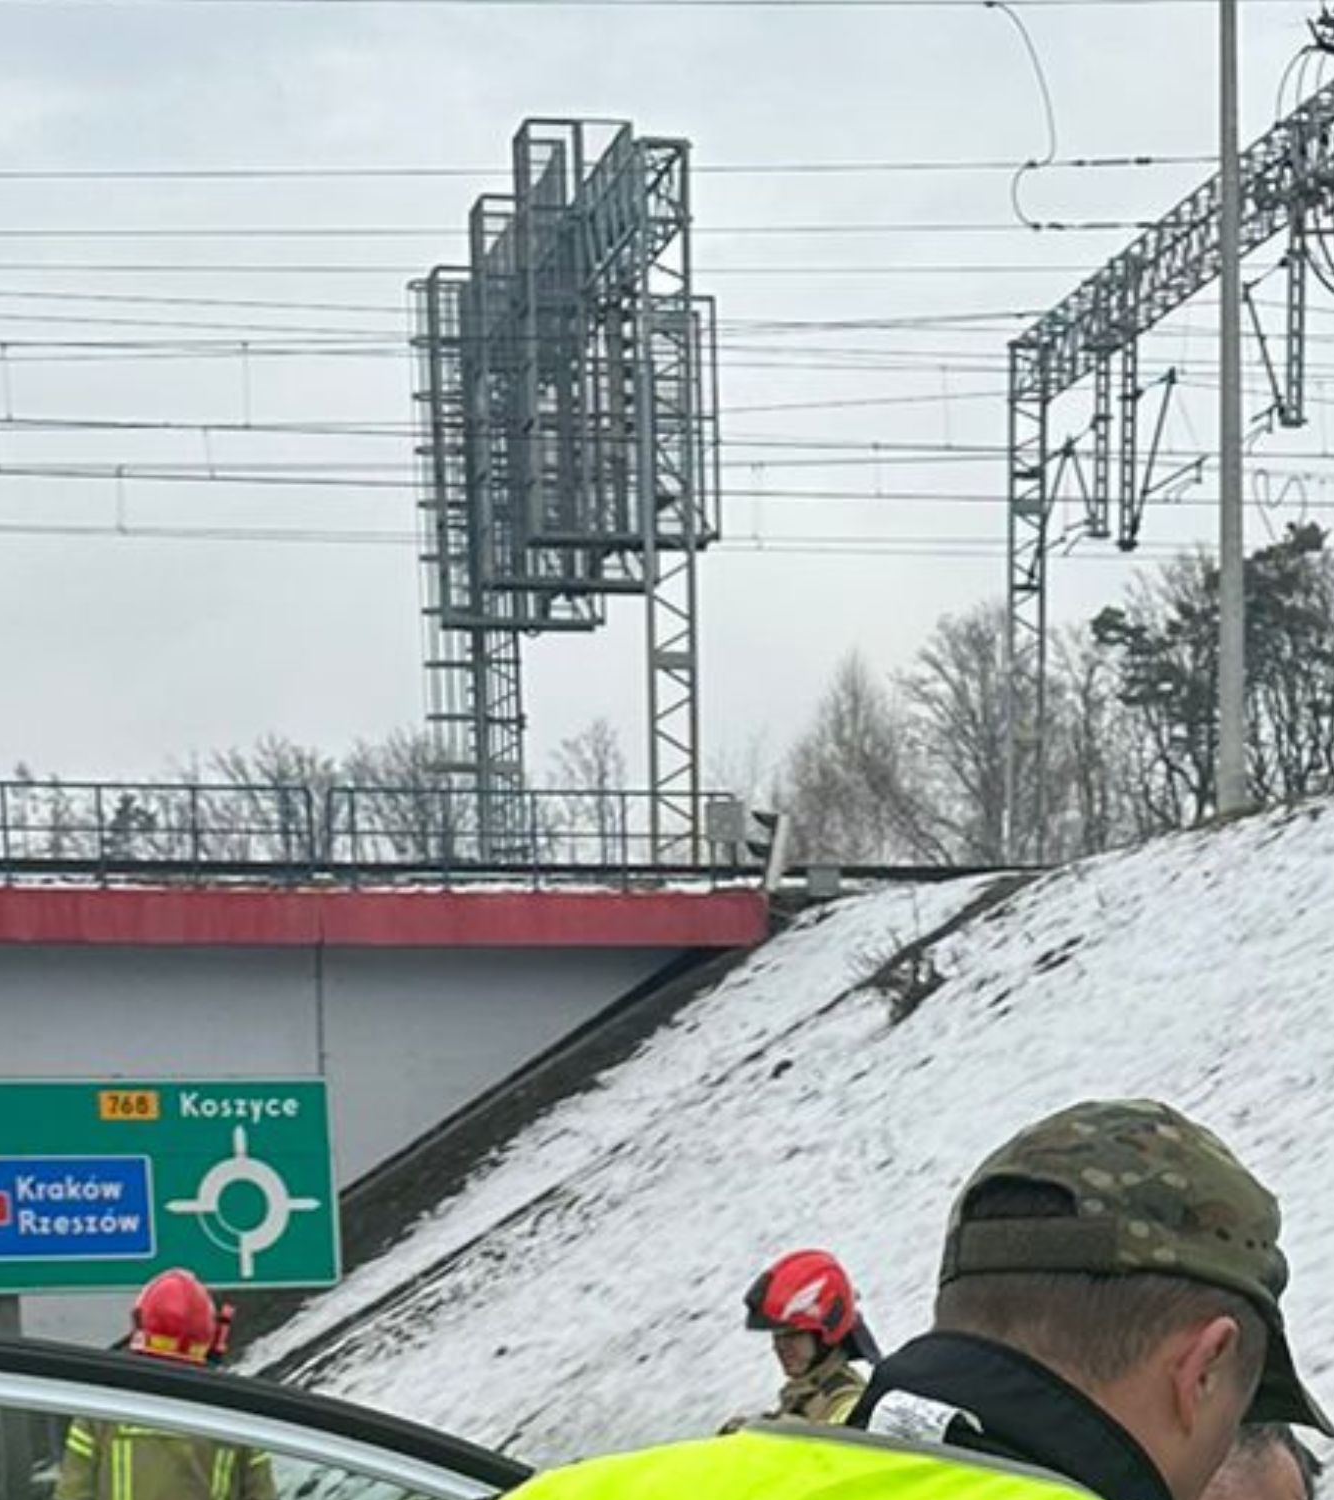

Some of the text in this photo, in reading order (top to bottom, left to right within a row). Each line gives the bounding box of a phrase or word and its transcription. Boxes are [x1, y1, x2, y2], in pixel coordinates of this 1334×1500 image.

[107, 1091, 299, 1123] 768 Koszyce
[16, 1174, 123, 1201] Kraków
[18, 1207, 140, 1235] Rzeszów
